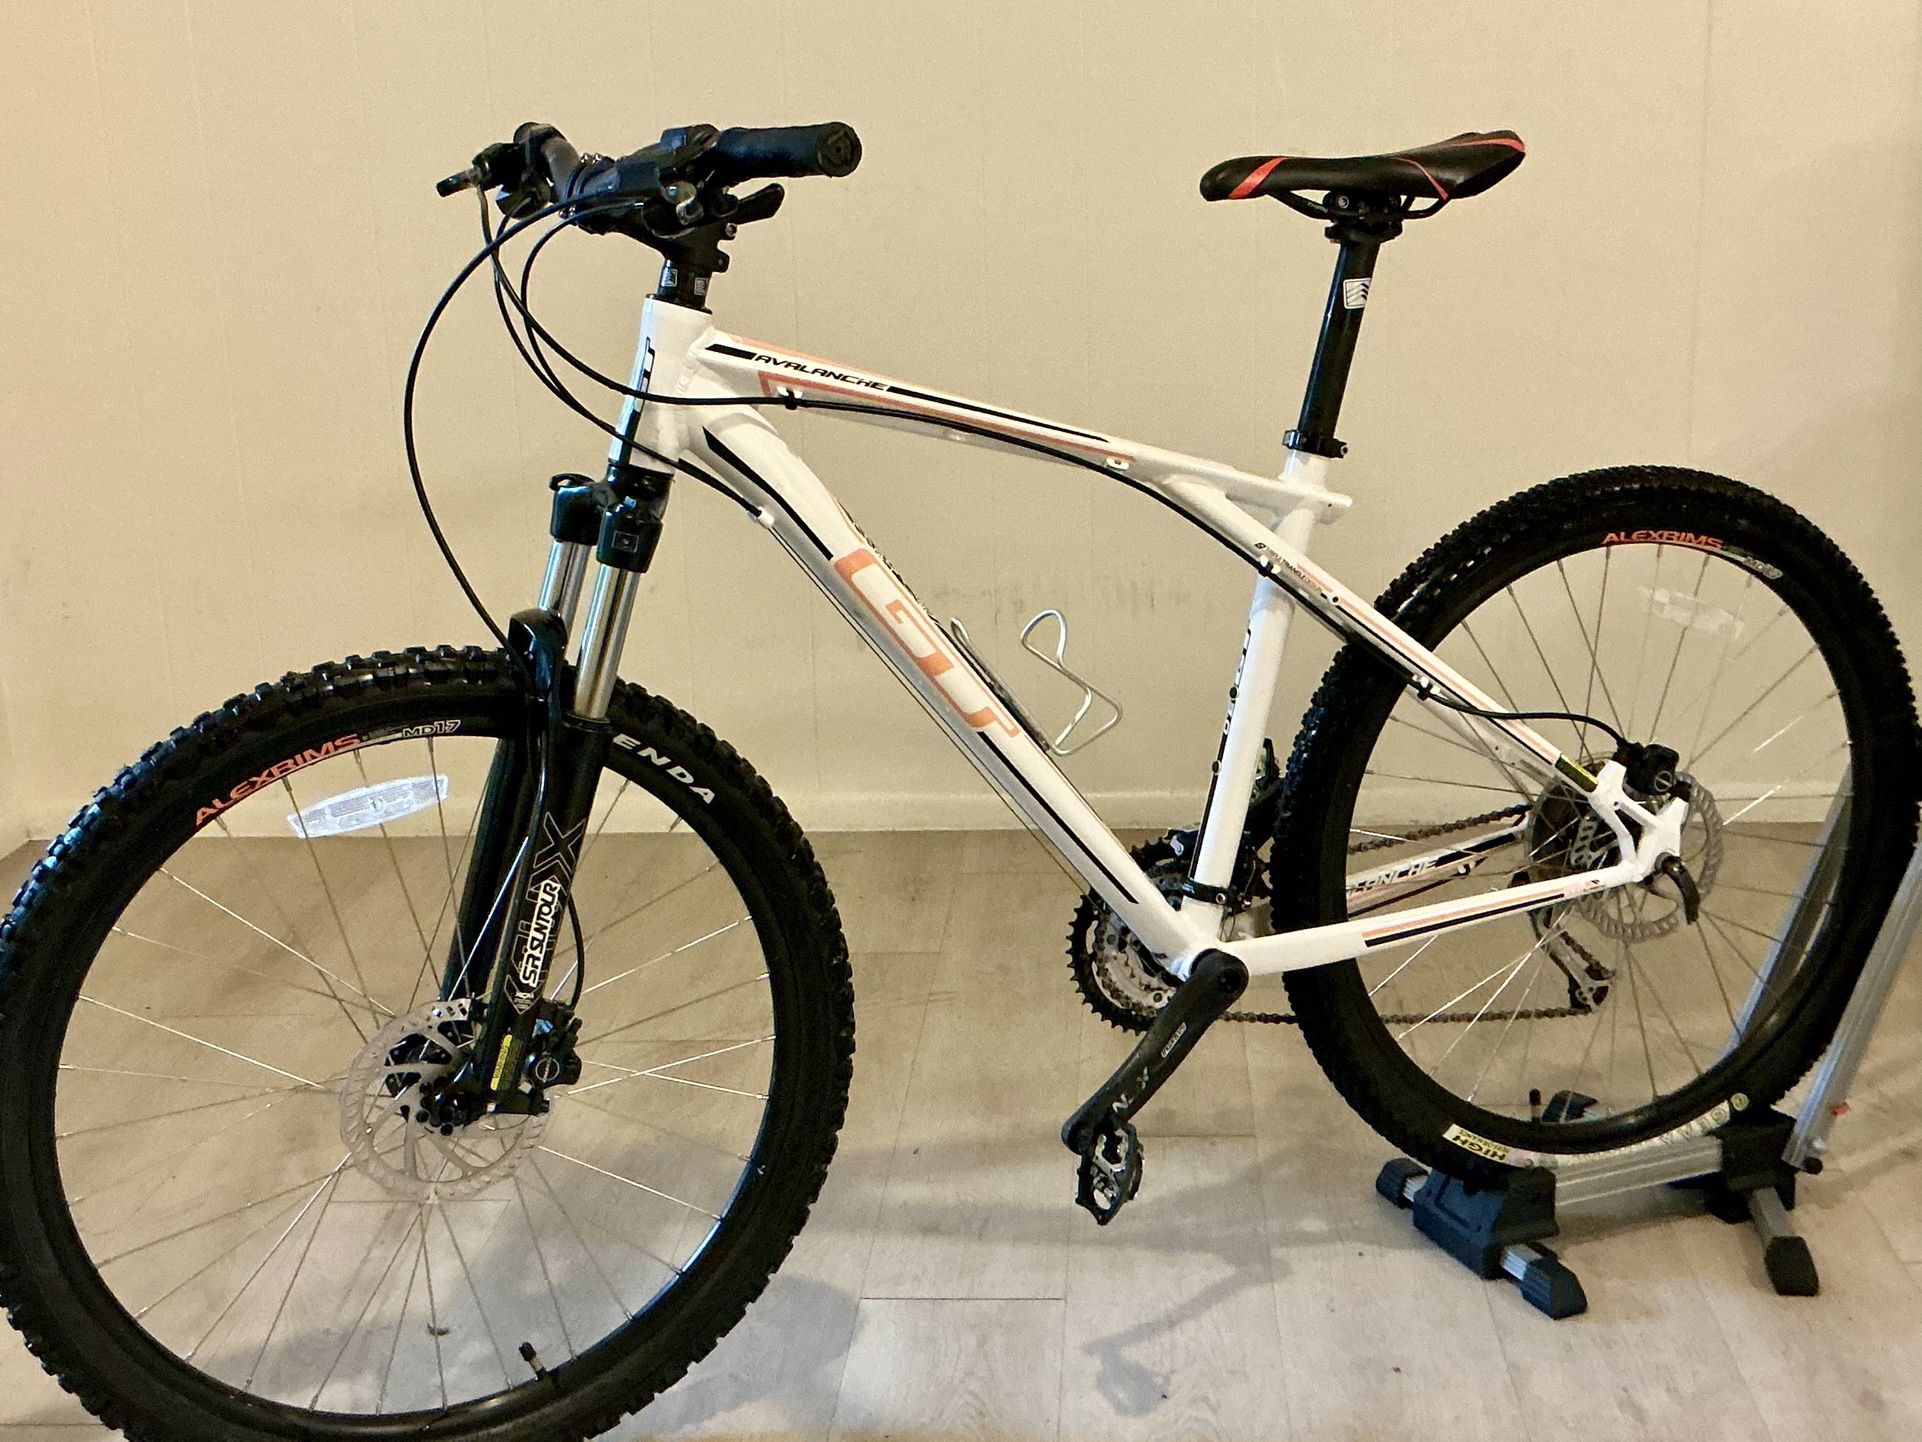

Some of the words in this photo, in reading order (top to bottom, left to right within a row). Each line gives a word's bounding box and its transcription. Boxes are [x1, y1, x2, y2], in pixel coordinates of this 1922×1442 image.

[755, 355, 889, 391] AVALANCHE
[1602, 530, 1724, 550] ALEXRIMS
[196, 733, 361, 826] ALEXRIMS
[402, 719, 461, 738] MD17
[612, 733, 716, 805] ENDA
[527, 879, 561, 953] SUNTOUR
[520, 952, 542, 988] SR
[1452, 1135, 1506, 1161] HIGH
